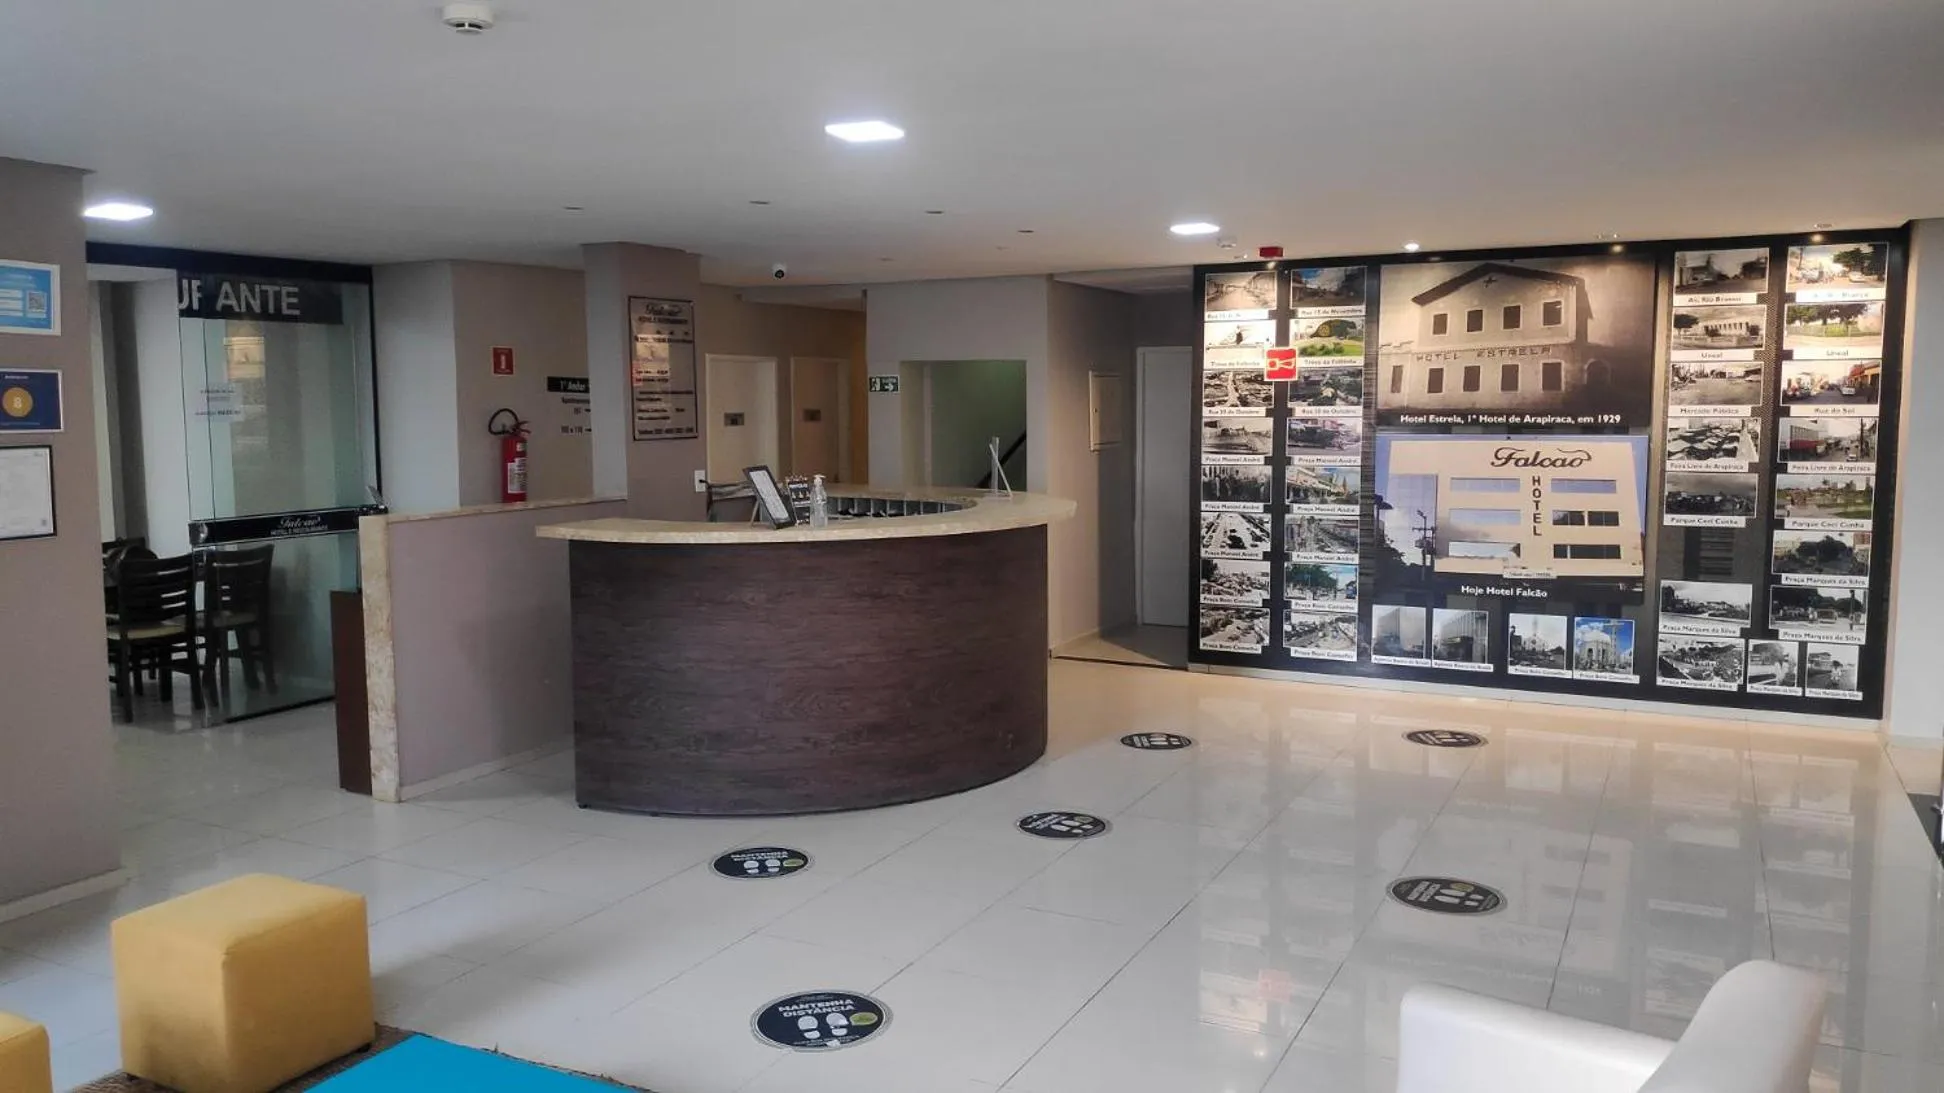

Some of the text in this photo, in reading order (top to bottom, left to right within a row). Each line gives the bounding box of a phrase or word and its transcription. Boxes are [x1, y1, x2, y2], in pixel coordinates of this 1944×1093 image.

[1416, 346, 1551, 361] HOTEL ESTRELA
[1401, 414, 1427, 423] Hotel
[1429, 414, 1464, 424] Estrela,
[1479, 414, 1506, 424] Hotel
[1508, 415, 1521, 424] de
[1523, 415, 1575, 425] Arapiraca,
[1598, 414, 1621, 424] 1929
[1531, 476, 1543, 536] HOTEL
[1461, 585, 1548, 598] Hoje Hotel Falcão
[778, 999, 854, 1012] MANTENHA
